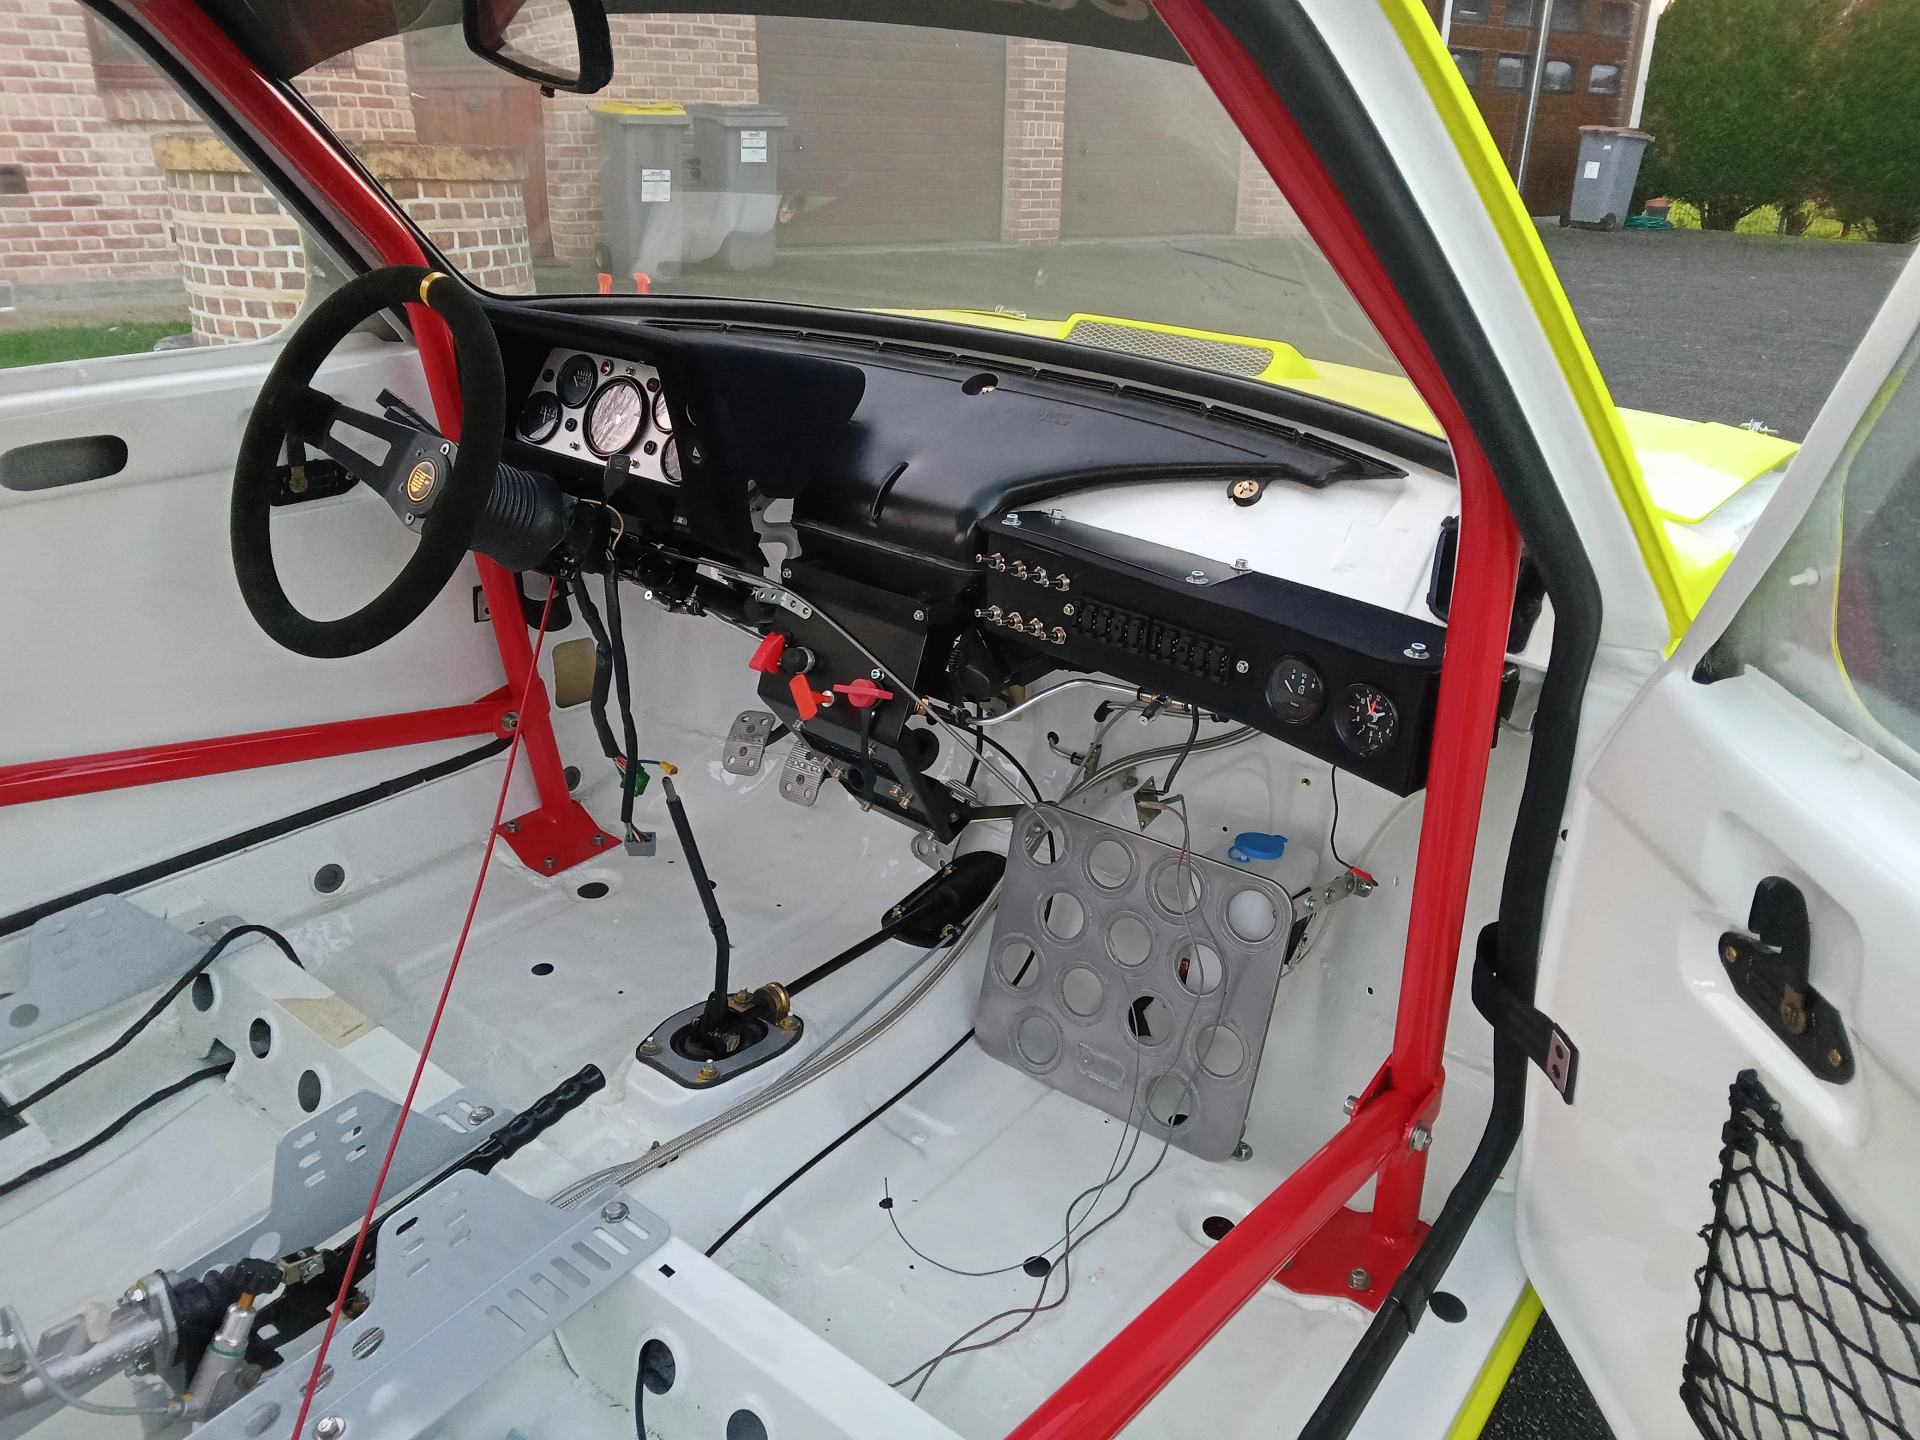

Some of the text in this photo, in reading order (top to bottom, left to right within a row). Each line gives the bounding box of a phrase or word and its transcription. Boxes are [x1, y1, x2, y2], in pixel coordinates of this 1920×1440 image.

[1360, 697, 1366, 705] 10
[1356, 705, 1360, 713] 9
[785, 758, 824, 774] sparco
